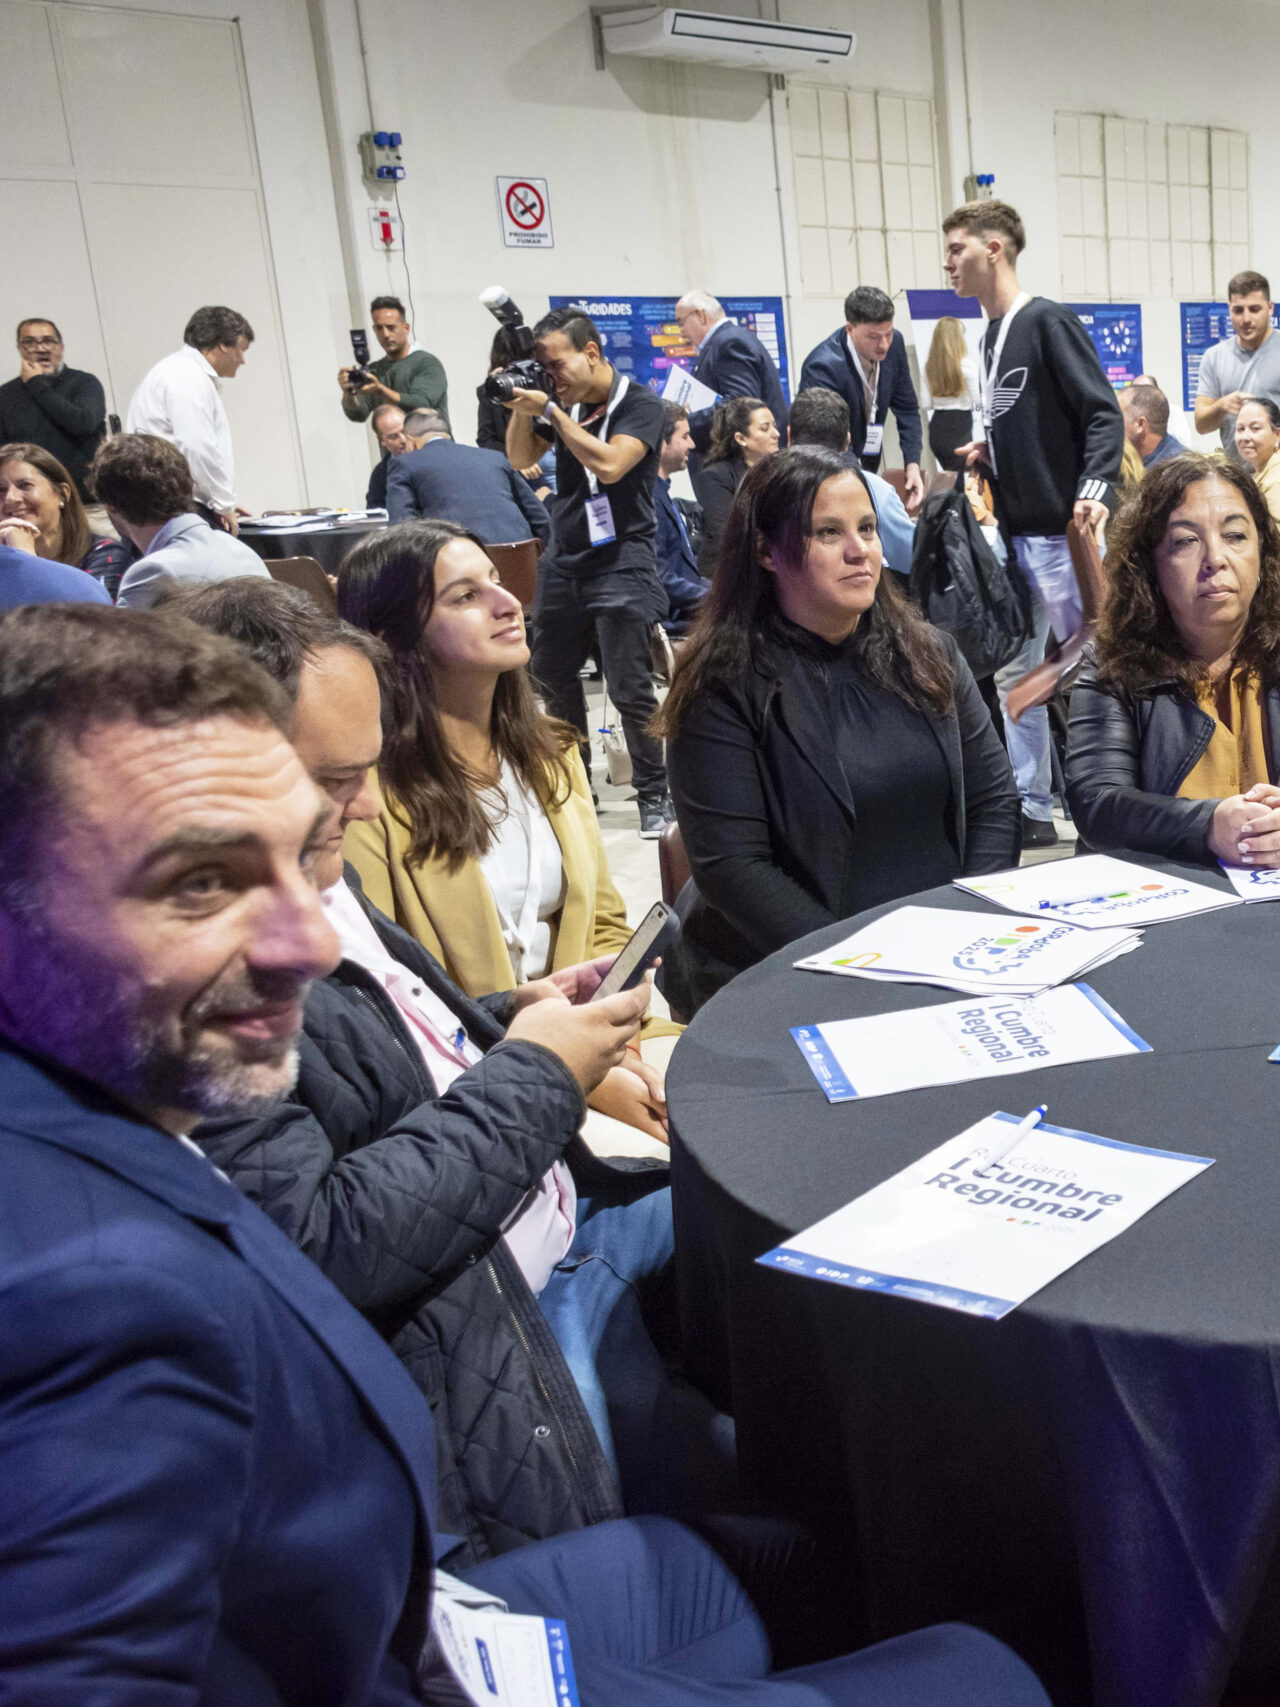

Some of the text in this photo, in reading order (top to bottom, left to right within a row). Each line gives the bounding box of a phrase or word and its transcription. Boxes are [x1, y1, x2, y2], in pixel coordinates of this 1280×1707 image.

[508, 231, 548, 239] PROHIBIDO
[568, 299, 633, 316] TURIDADES
[956, 1008, 1025, 1064] Regional
[995, 1010, 1051, 1058] Cumbre
[972, 1162, 1124, 1207] Cumbre
[1008, 1155, 1078, 1181] Cuarto
[923, 1172, 1103, 1223] Regional
